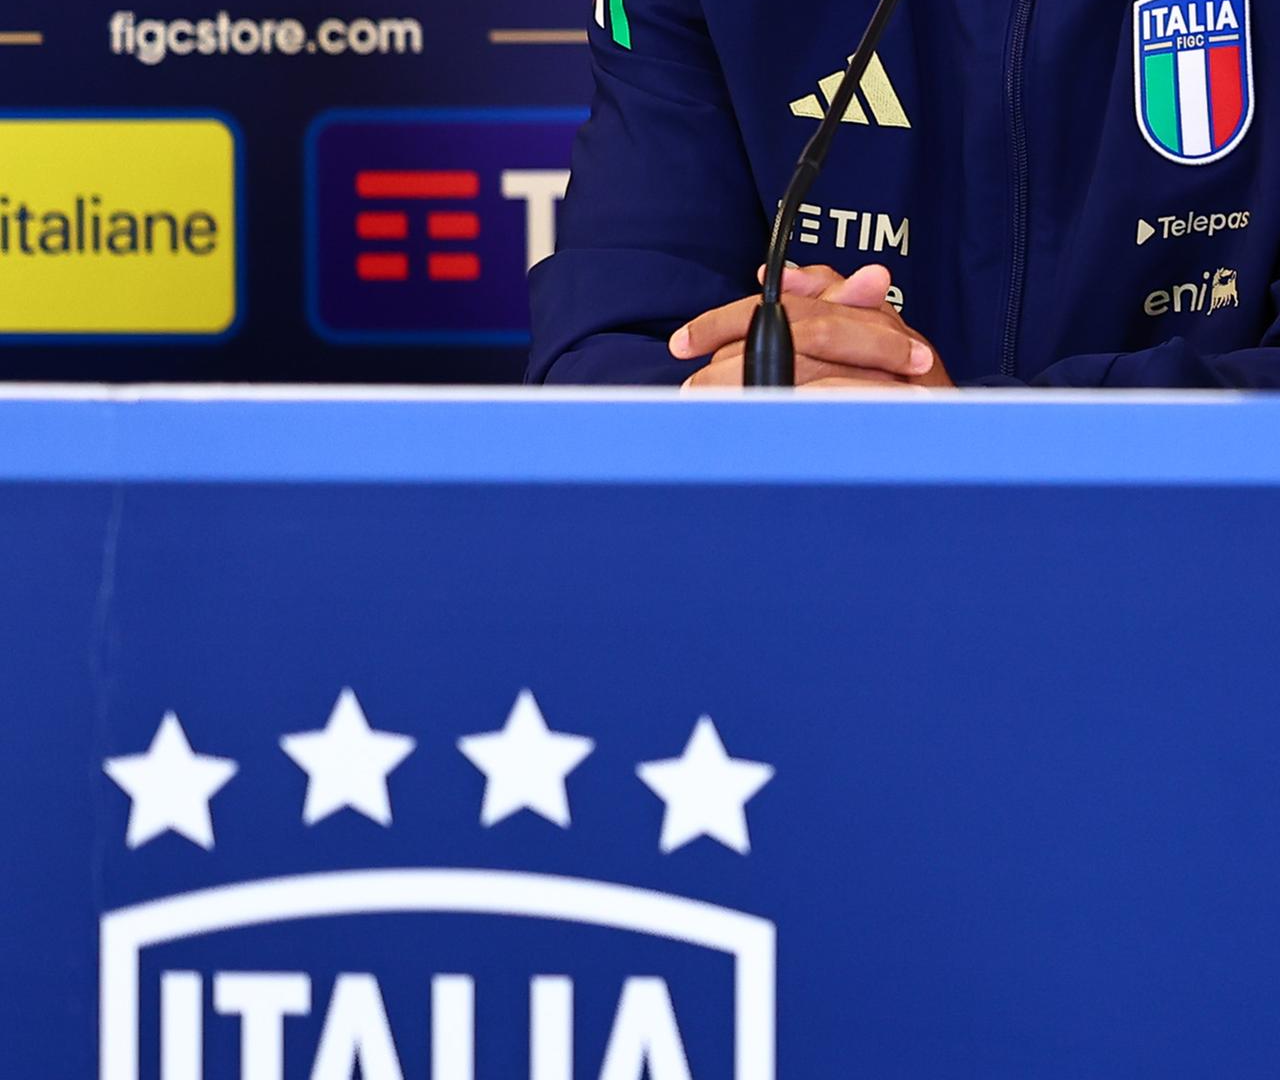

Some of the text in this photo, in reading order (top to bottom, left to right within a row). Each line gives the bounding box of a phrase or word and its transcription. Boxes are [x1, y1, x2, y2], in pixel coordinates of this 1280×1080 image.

[109, 10, 423, 65] figcstore.com
[1142, 0, 1240, 41] ITALIA
[1176, 34, 1205, 50] FIGC
[829, 208, 909, 257] TIM
[1144, 271, 1211, 316] eni
